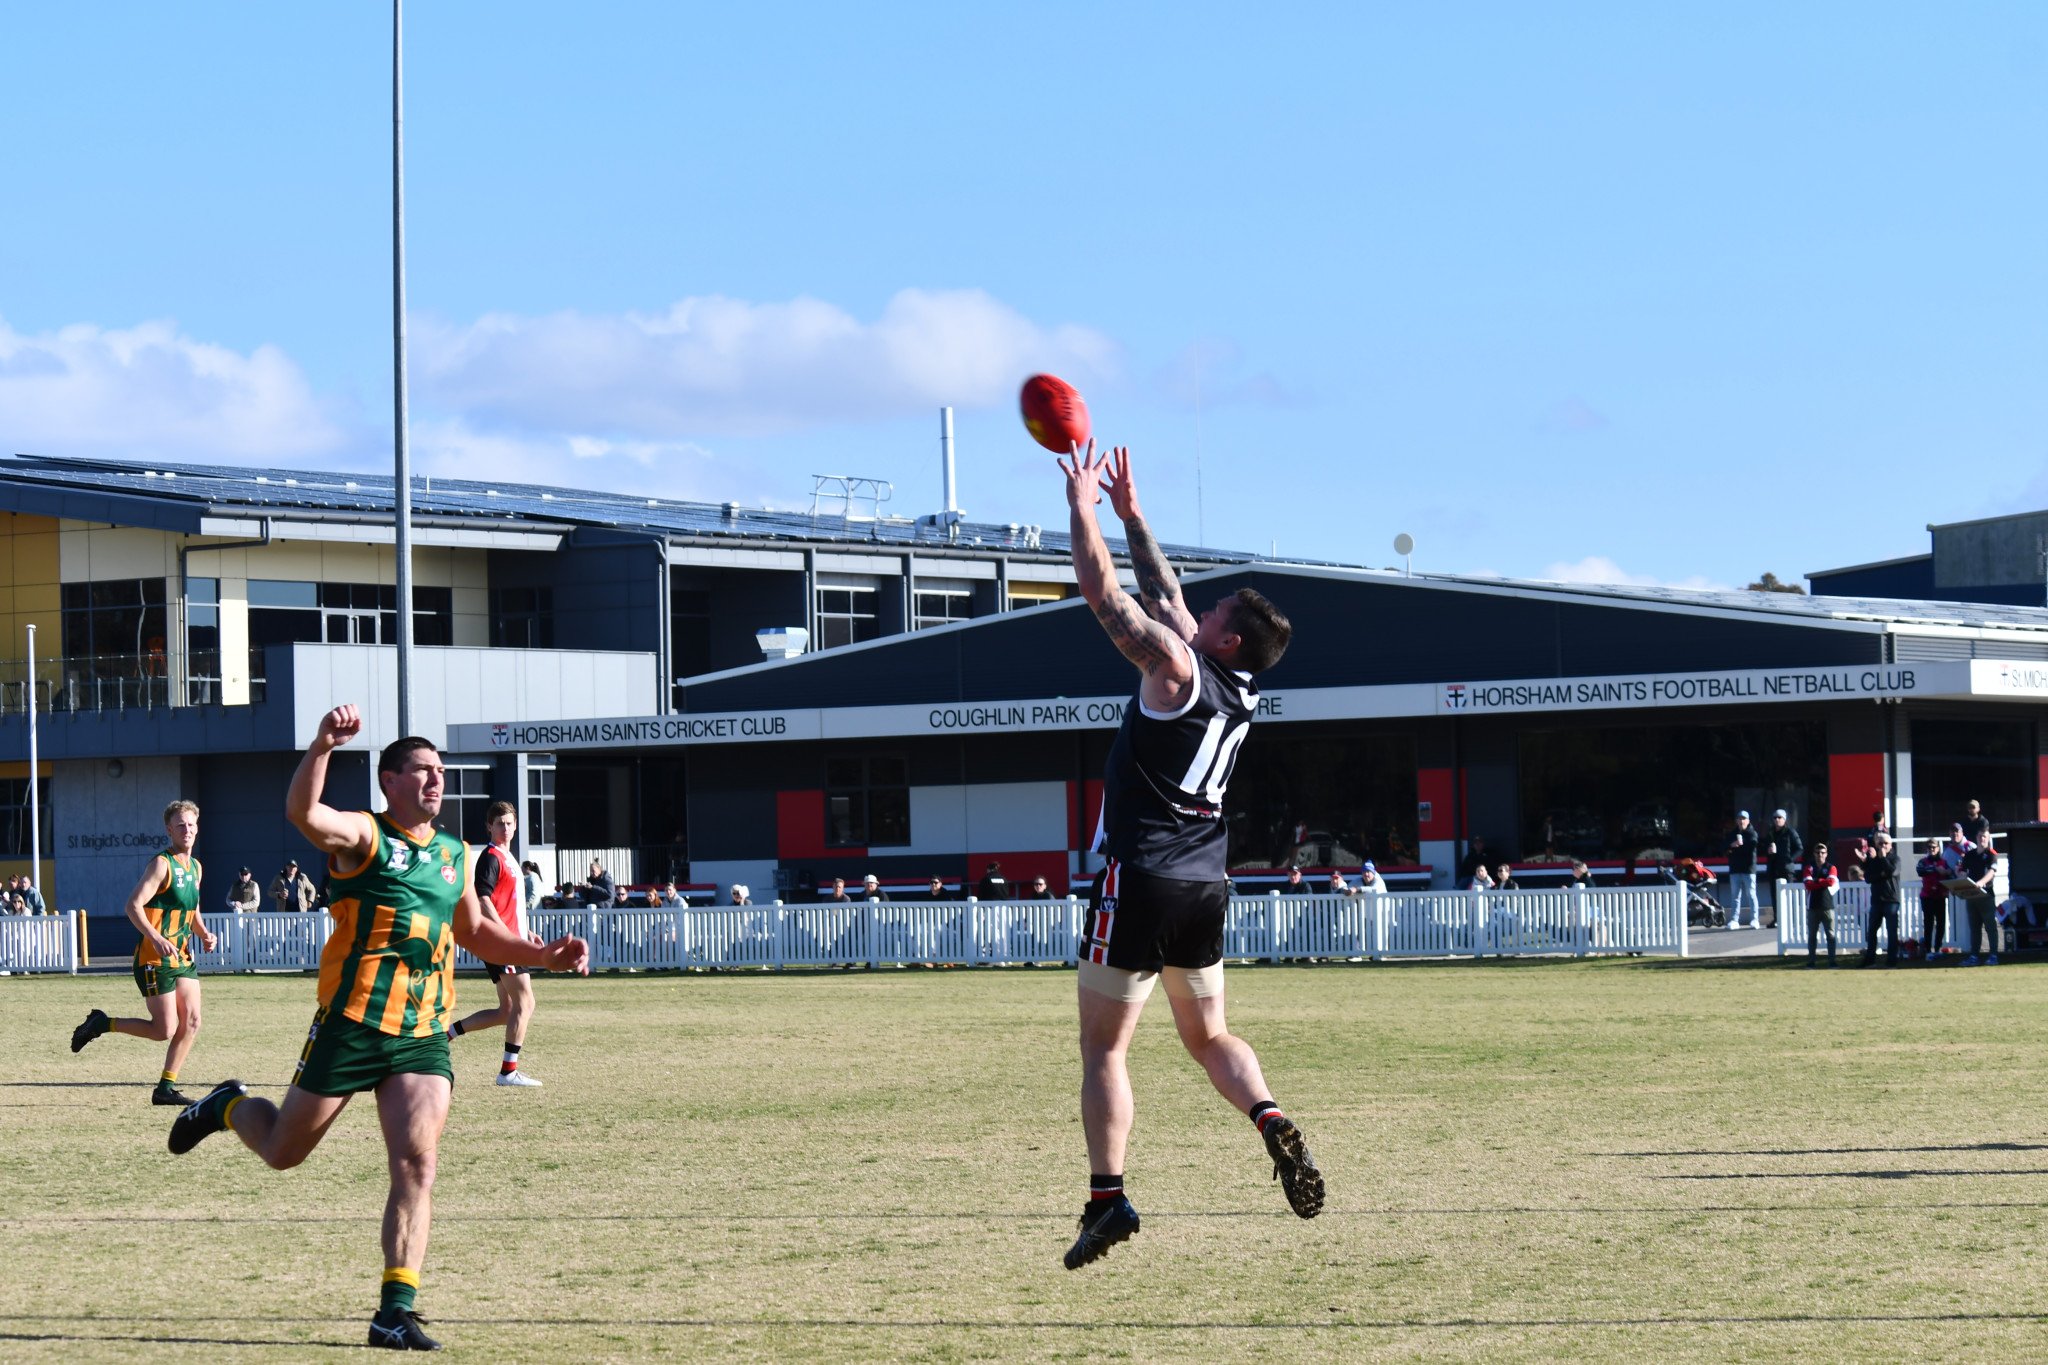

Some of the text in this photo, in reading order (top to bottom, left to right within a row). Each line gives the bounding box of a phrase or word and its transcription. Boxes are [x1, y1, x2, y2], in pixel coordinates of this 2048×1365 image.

[1472, 670, 1916, 706] HORSHAM SAINTS FOOTBALL NETBALL CLUB
[929, 707, 1026, 728] COUGHLIN
[1031, 705, 1081, 724] PARK
[513, 717, 787, 745] HORSHAM SAINTS CRICKET CLUB
[68, 833, 169, 851] St Brigid's College
